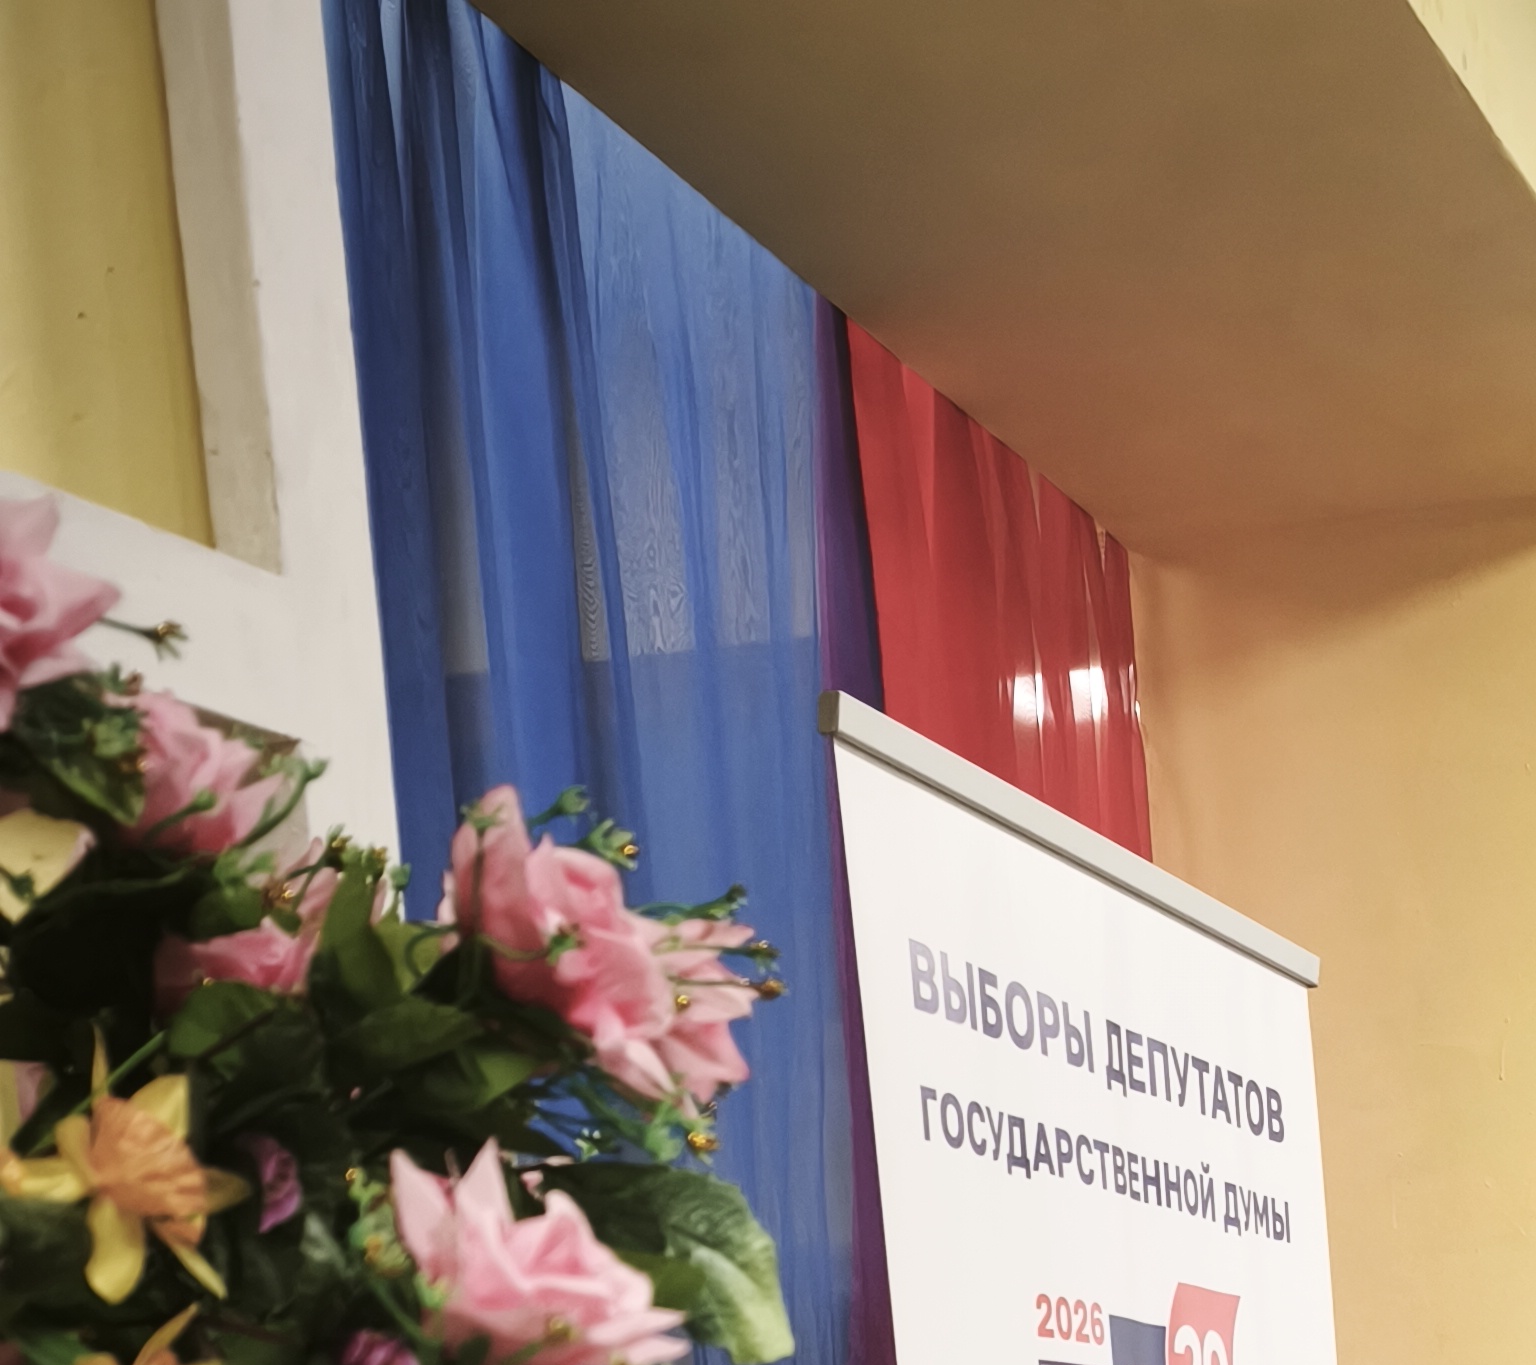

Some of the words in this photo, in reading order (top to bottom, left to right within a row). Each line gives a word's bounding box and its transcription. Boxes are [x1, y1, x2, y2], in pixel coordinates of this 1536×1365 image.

[908, 938, 1095, 1073] ВЫБОРЫ
[1105, 1018, 1285, 1143] ДЕПУТАТОВ
[920, 1084, 1216, 1223] ГОСУДАРСТВЕННОЙ
[1223, 1180, 1291, 1244] ДУМЫ
[1035, 1293, 1105, 1346] 2026
